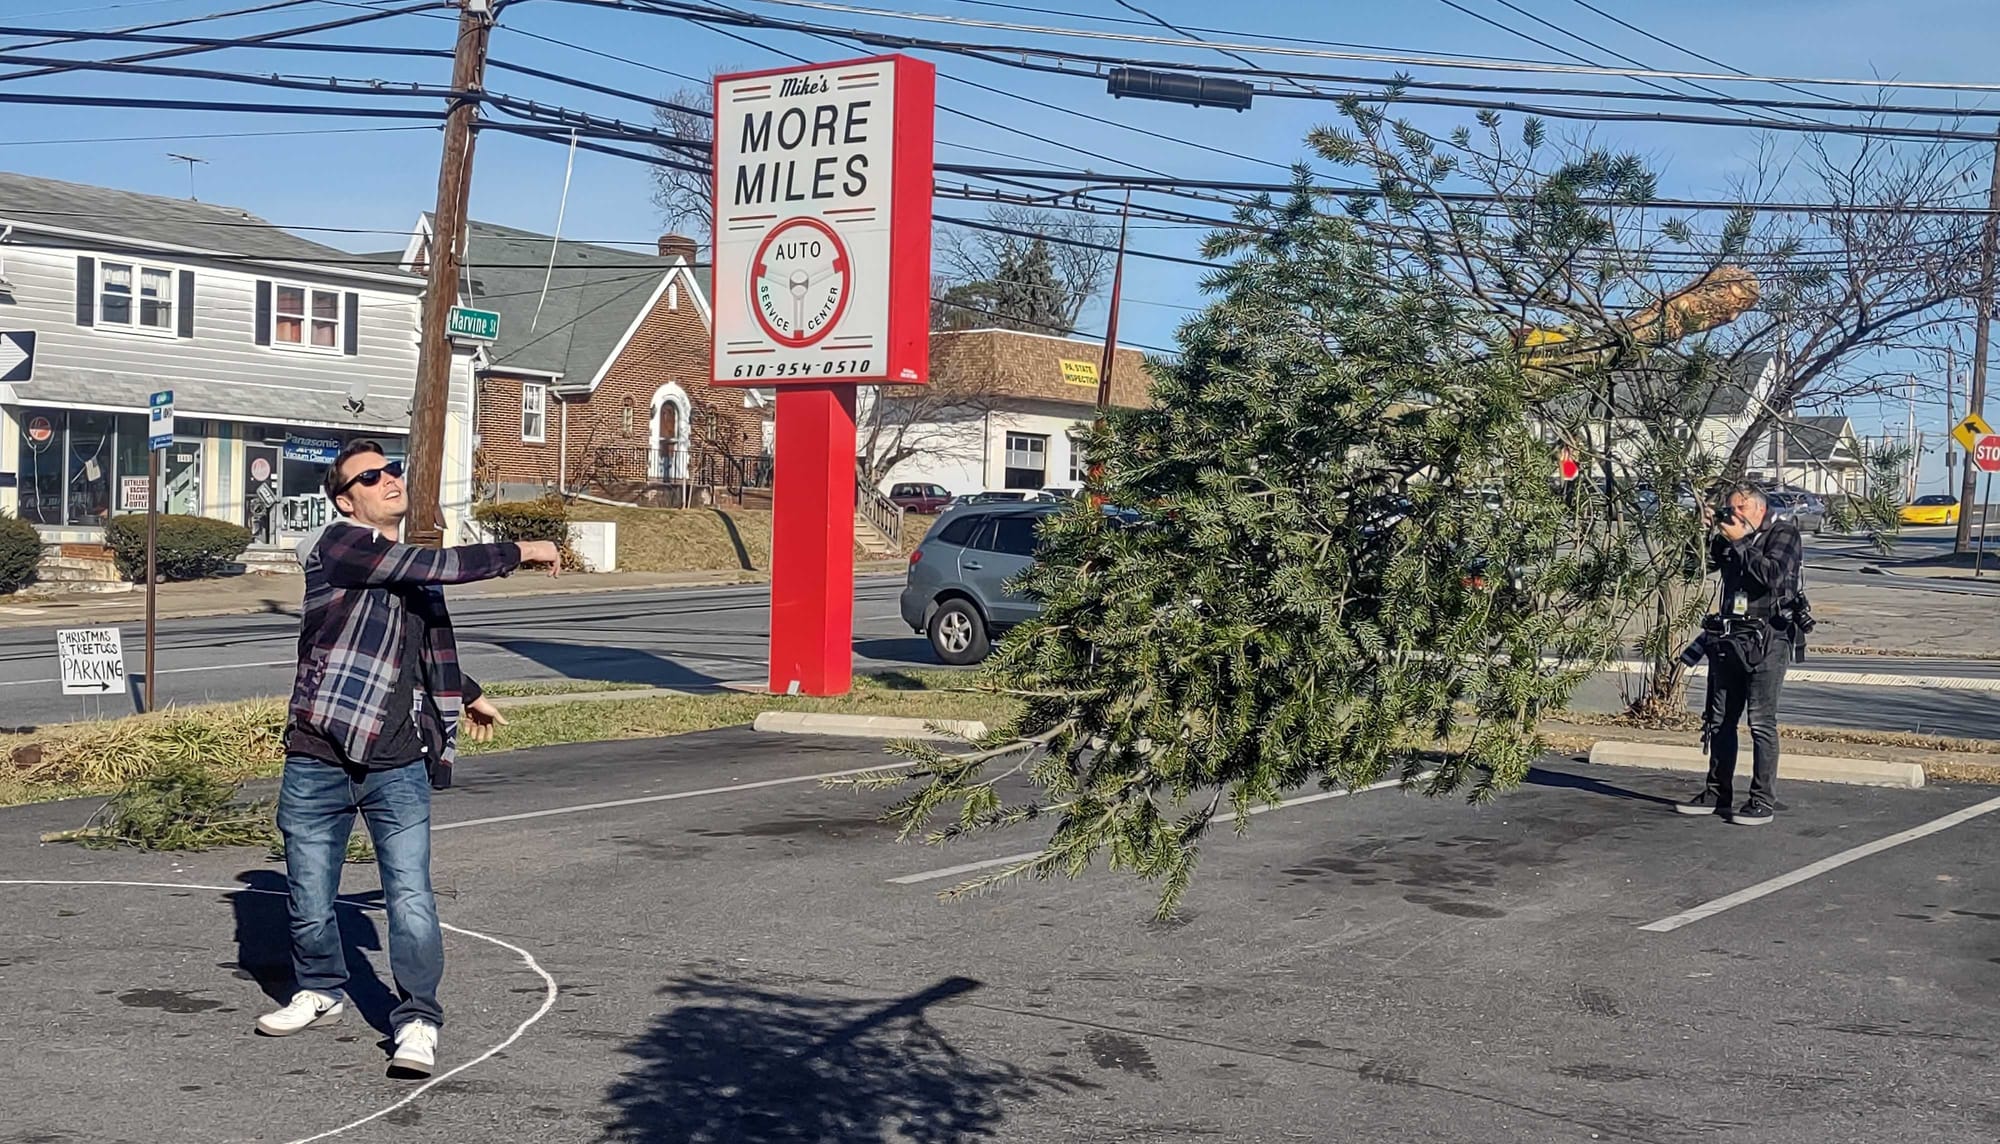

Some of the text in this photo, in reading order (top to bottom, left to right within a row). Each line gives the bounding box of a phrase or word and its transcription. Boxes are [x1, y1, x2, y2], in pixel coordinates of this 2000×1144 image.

[778, 74, 829, 98] Mike's
[740, 100, 872, 154] MORE
[734, 154, 869, 206] MILES
[775, 240, 822, 261] AUTO
[760, 285, 839, 332] SERVICE CENTER
[451, 309, 487, 334] Marvine
[733, 359, 871, 378] 610-954-0510
[1074, 364, 1093, 373] STATE
[1065, 373, 1099, 385] INSPECTION
[284, 431, 340, 449] Panasonic
[1977, 445, 2000, 461] STO
[124, 479, 149, 487] BETHLEHE
[59, 630, 111, 644] CHRISTMAS
[62, 658, 124, 681] PARKING
